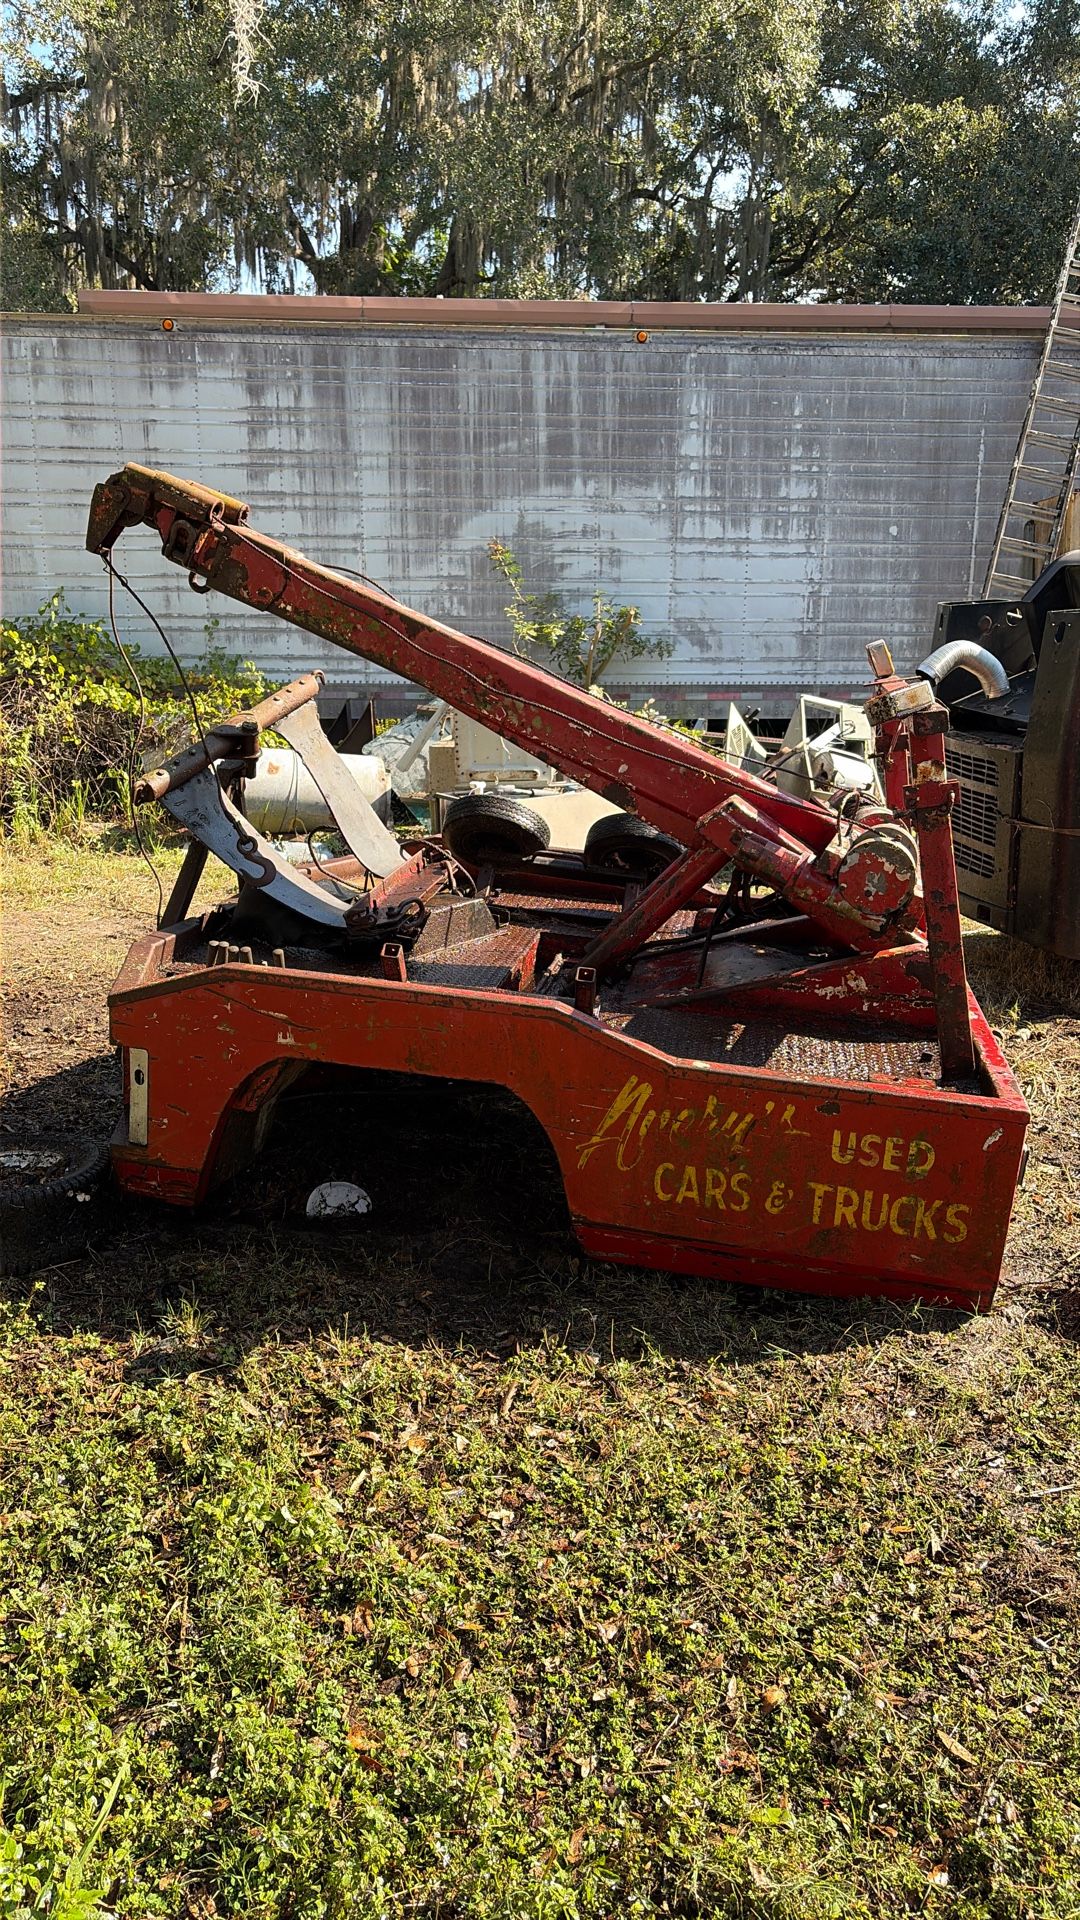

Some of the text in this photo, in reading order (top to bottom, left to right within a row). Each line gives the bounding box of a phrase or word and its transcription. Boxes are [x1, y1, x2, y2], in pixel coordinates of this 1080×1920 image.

[831, 1129, 936, 1178] USED
[653, 1162, 972, 1243] CARS & TRUCKS
